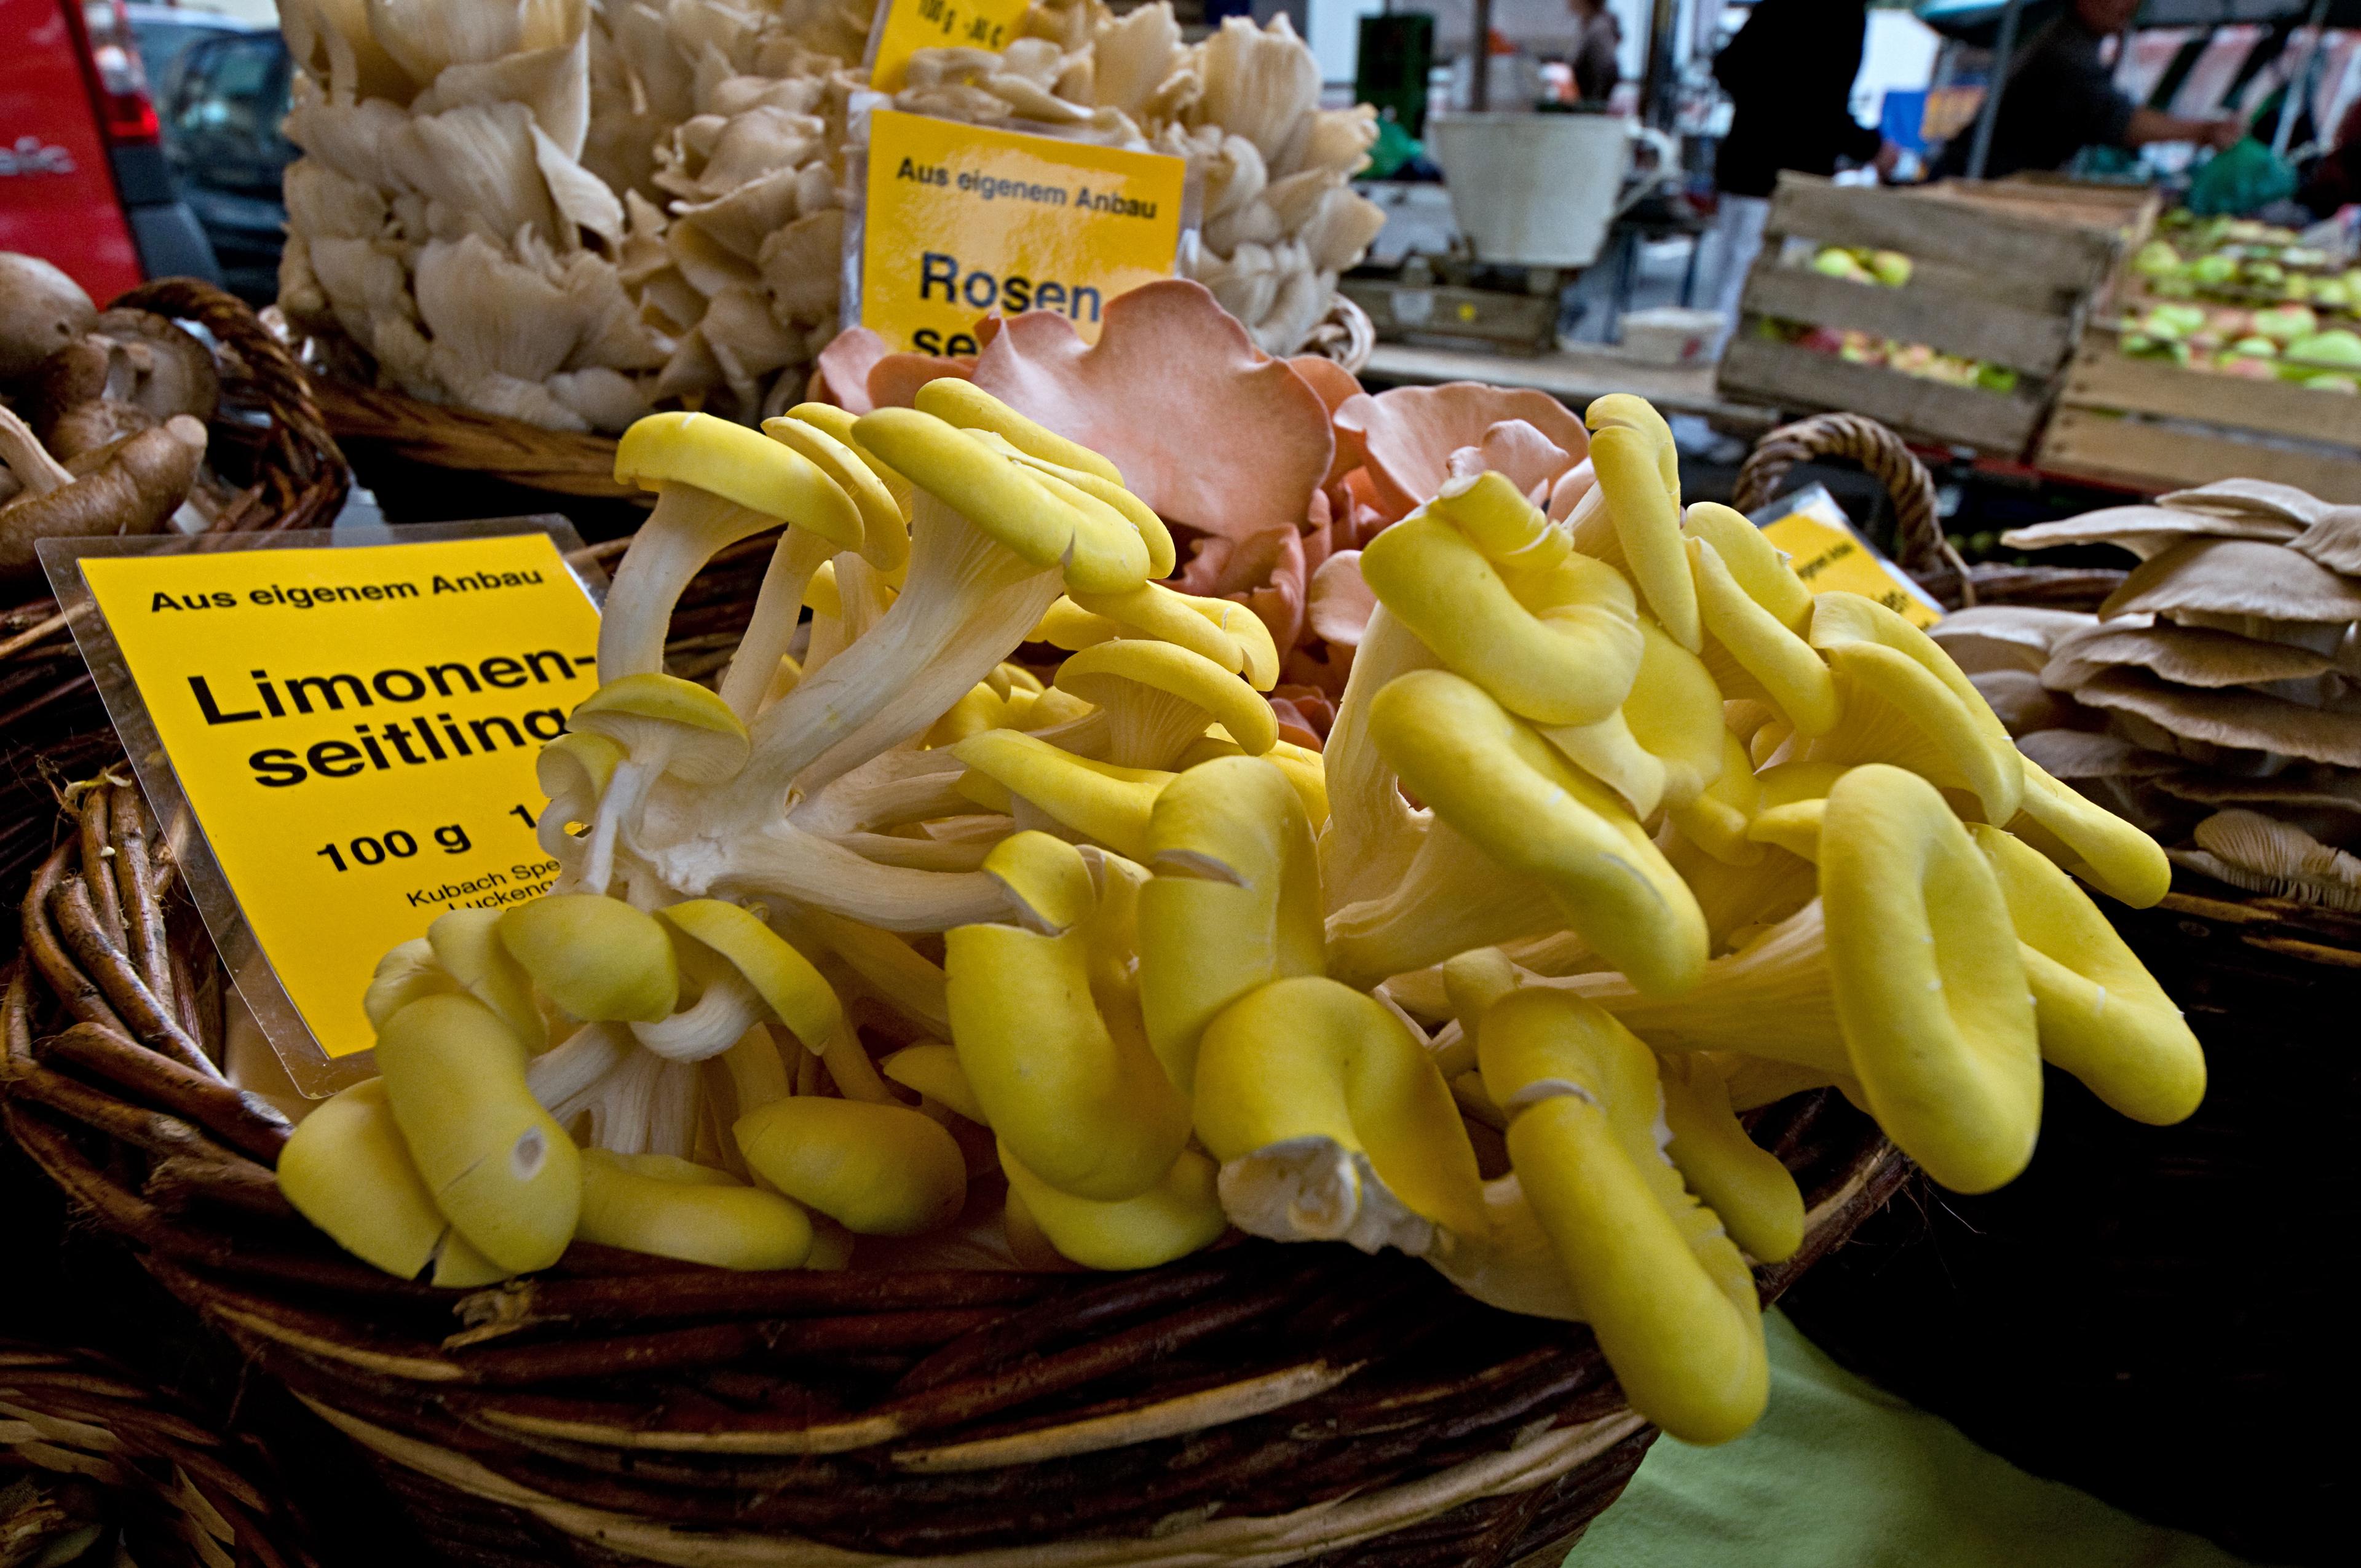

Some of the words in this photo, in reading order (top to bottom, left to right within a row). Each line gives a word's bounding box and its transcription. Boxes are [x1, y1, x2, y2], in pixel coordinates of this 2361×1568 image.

[897, 157, 949, 187] Aus
[957, 170, 1067, 205] eigenem
[1075, 186, 1157, 220] Anbau
[919, 251, 1102, 323] Rosen
[151, 592, 237, 613] Aus
[248, 580, 419, 609] eigenem
[432, 568, 544, 595] Anbau
[186, 649, 597, 726] Limonen-
[316, 830, 419, 873] 100
[433, 823, 472, 854] g
[406, 873, 507, 908] Kubach
[511, 860, 561, 879] Spe
